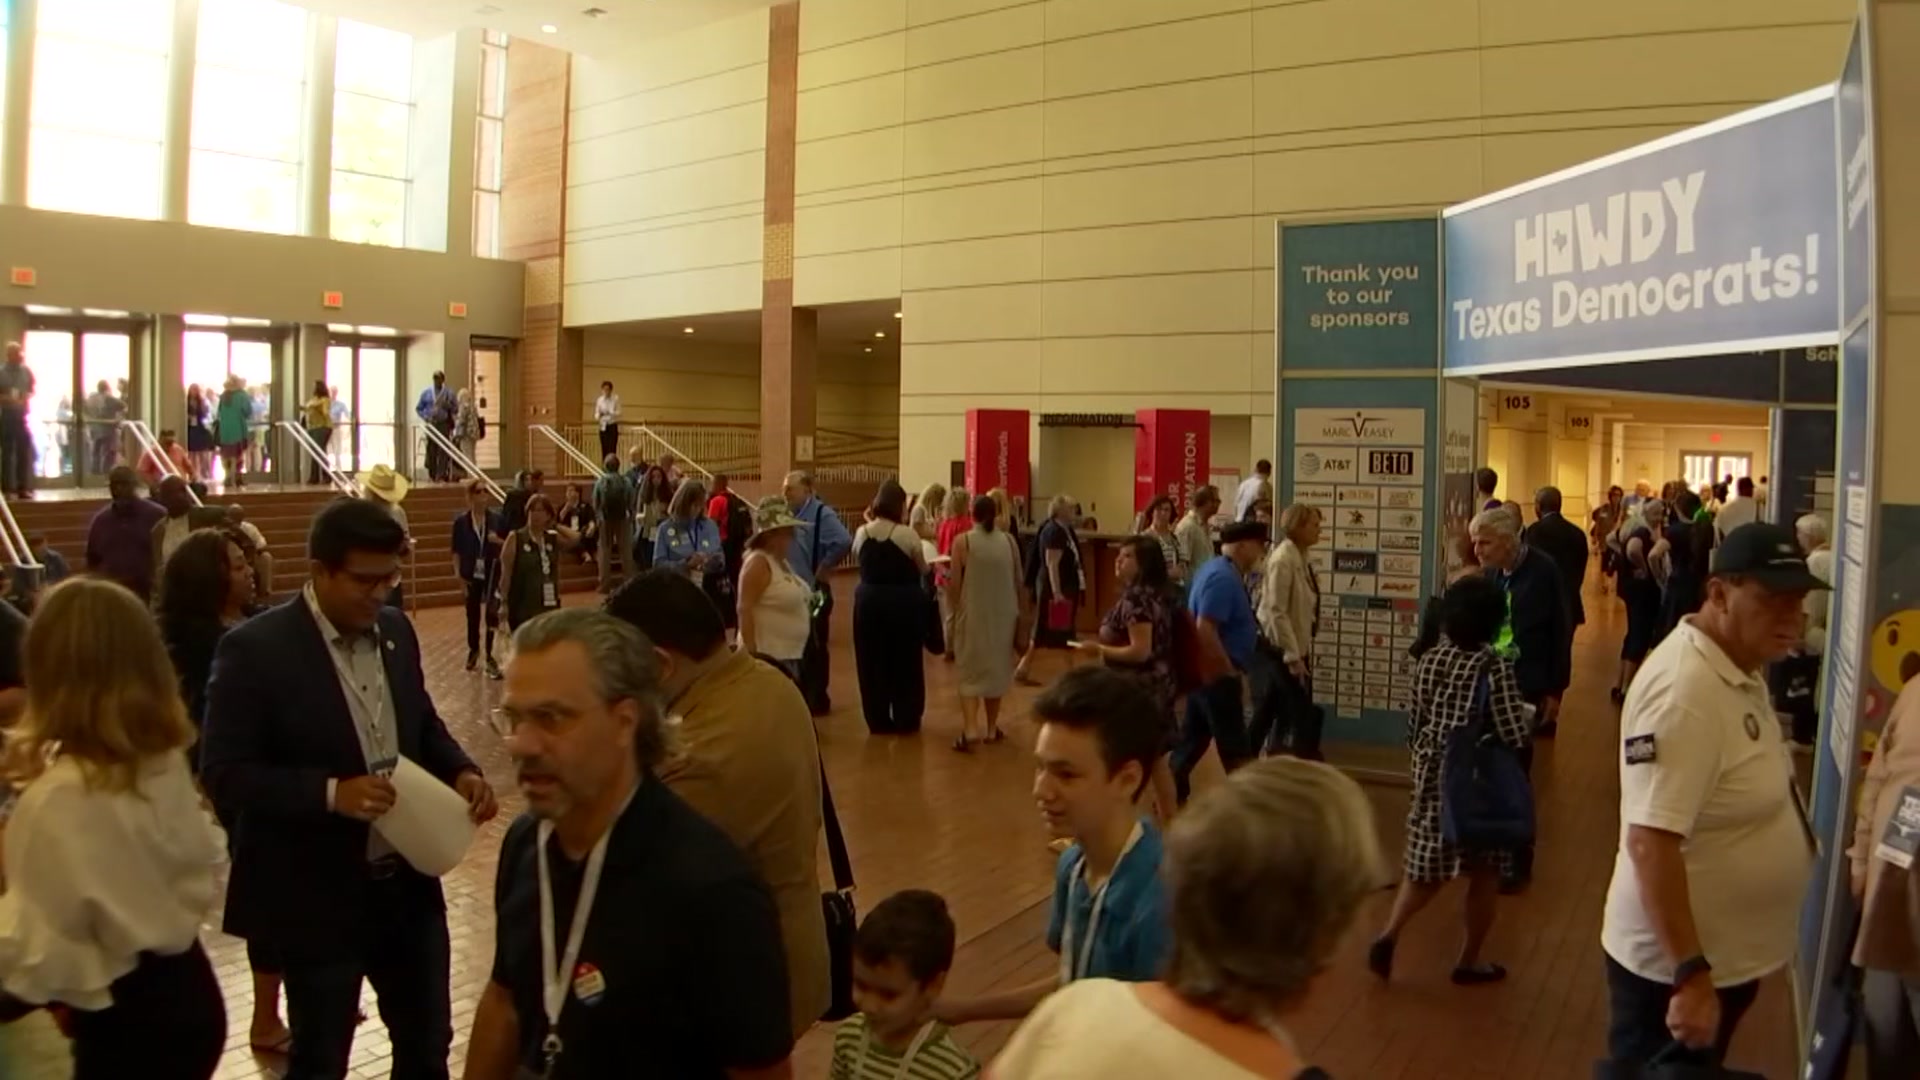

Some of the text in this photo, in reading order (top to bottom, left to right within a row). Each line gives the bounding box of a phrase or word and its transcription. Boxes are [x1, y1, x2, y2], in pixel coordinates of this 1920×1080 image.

[1514, 170, 1706, 283] HOWDY
[1301, 264, 1419, 286] Thank you
[1453, 233, 1820, 341] Texas Democrats!
[1326, 288, 1393, 304] to our
[1310, 311, 1410, 332] sponsors
[1805, 348, 1839, 362] Sch
[1504, 396, 1530, 409] 105
[1571, 417, 1590, 428] 105
[1322, 427, 1350, 437] MARC
[1323, 459, 1351, 471] AT&T
[1373, 453, 1409, 473] BETO
